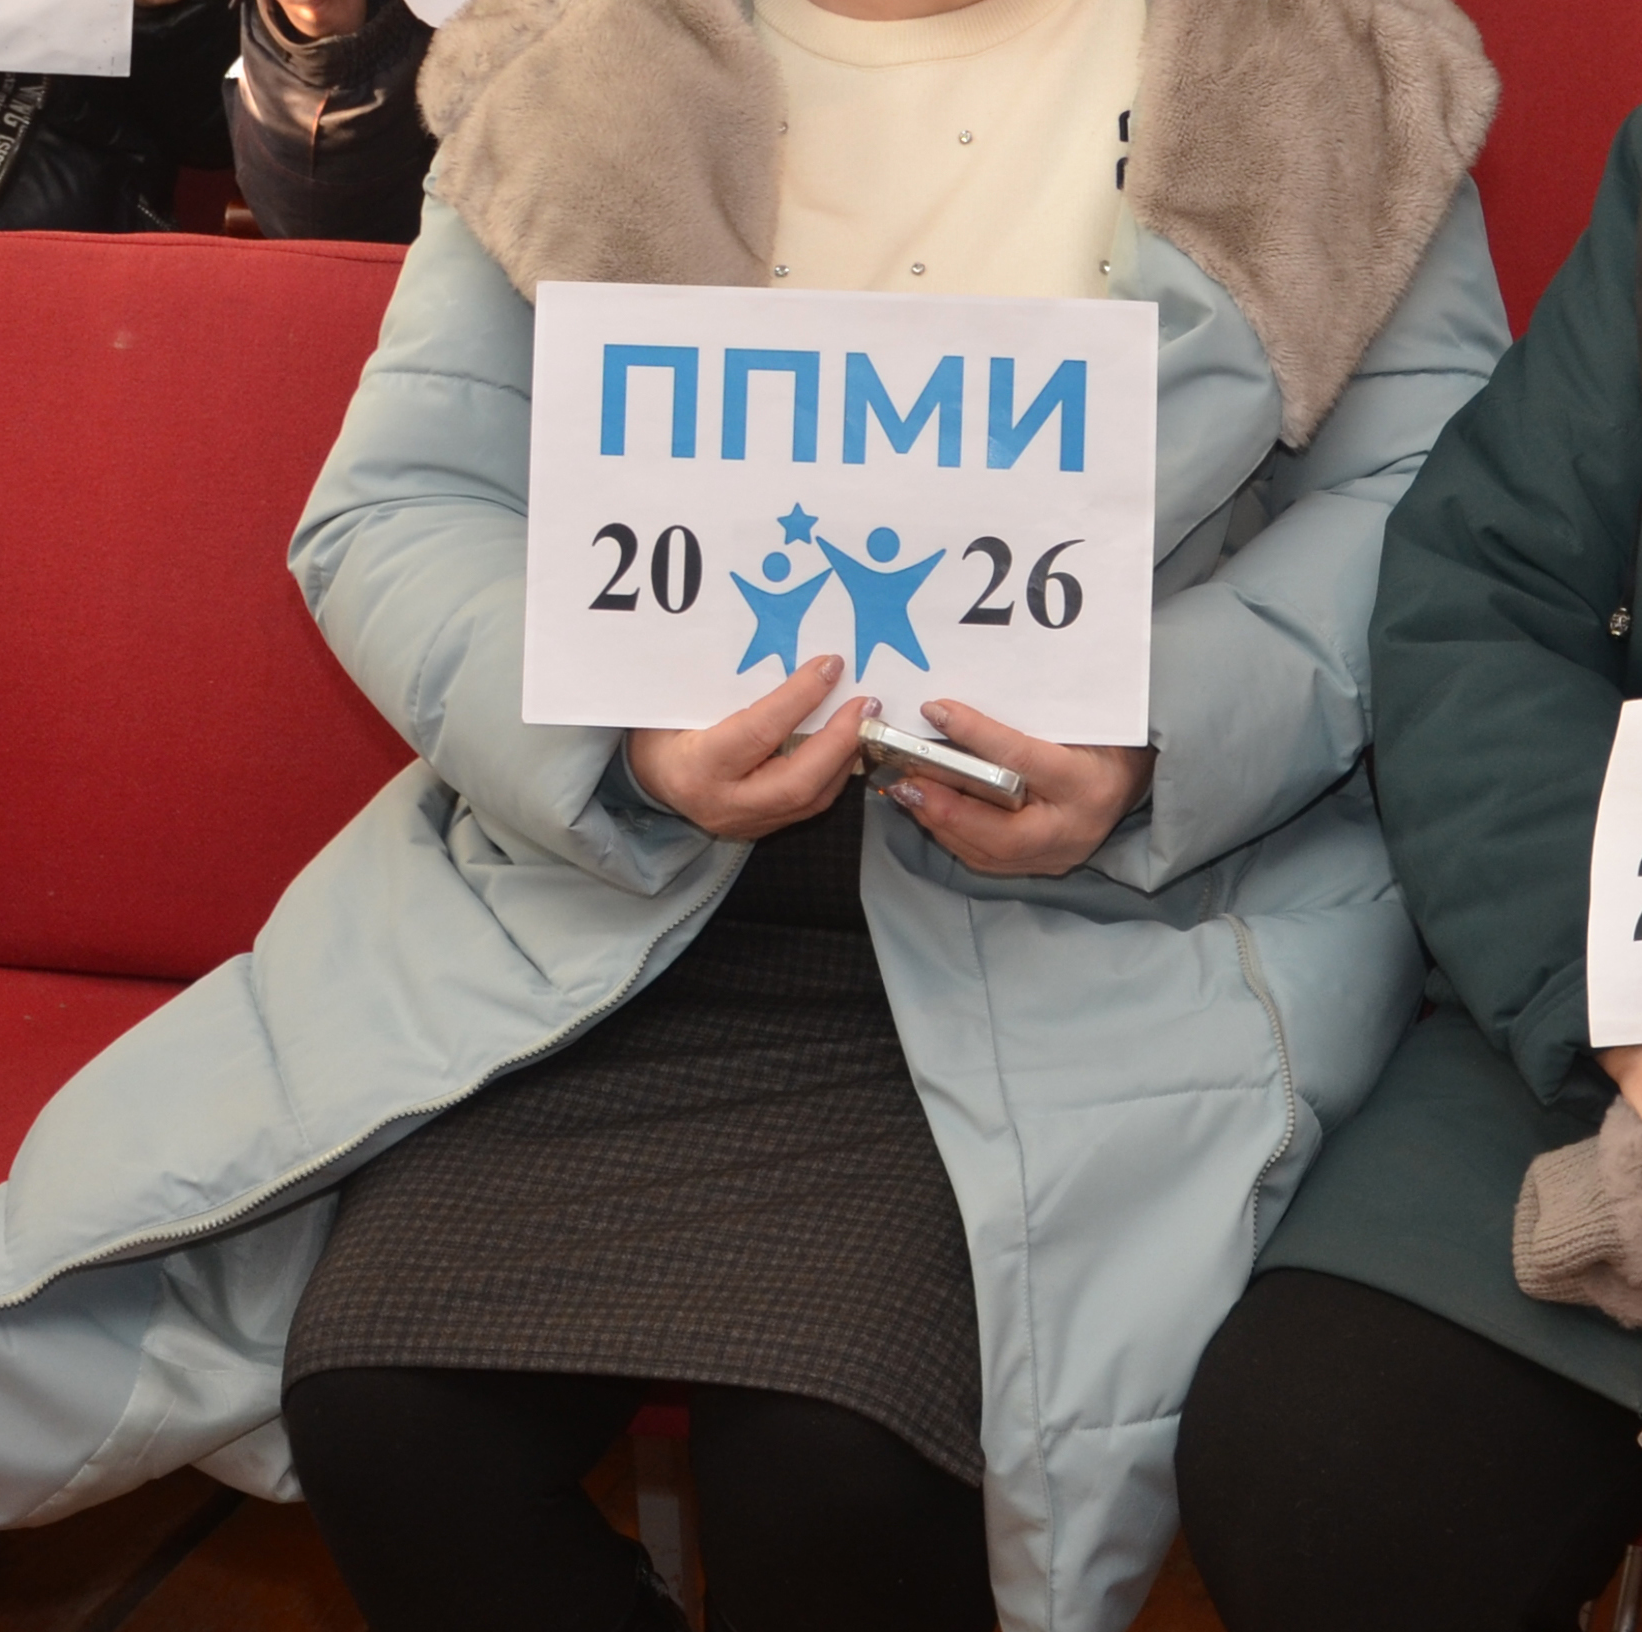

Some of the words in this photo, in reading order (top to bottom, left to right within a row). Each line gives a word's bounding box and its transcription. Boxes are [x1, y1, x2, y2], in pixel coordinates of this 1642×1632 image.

[599, 343, 1088, 473] ППМИ
[588, 522, 703, 615] 20
[958, 535, 1086, 630] 26
